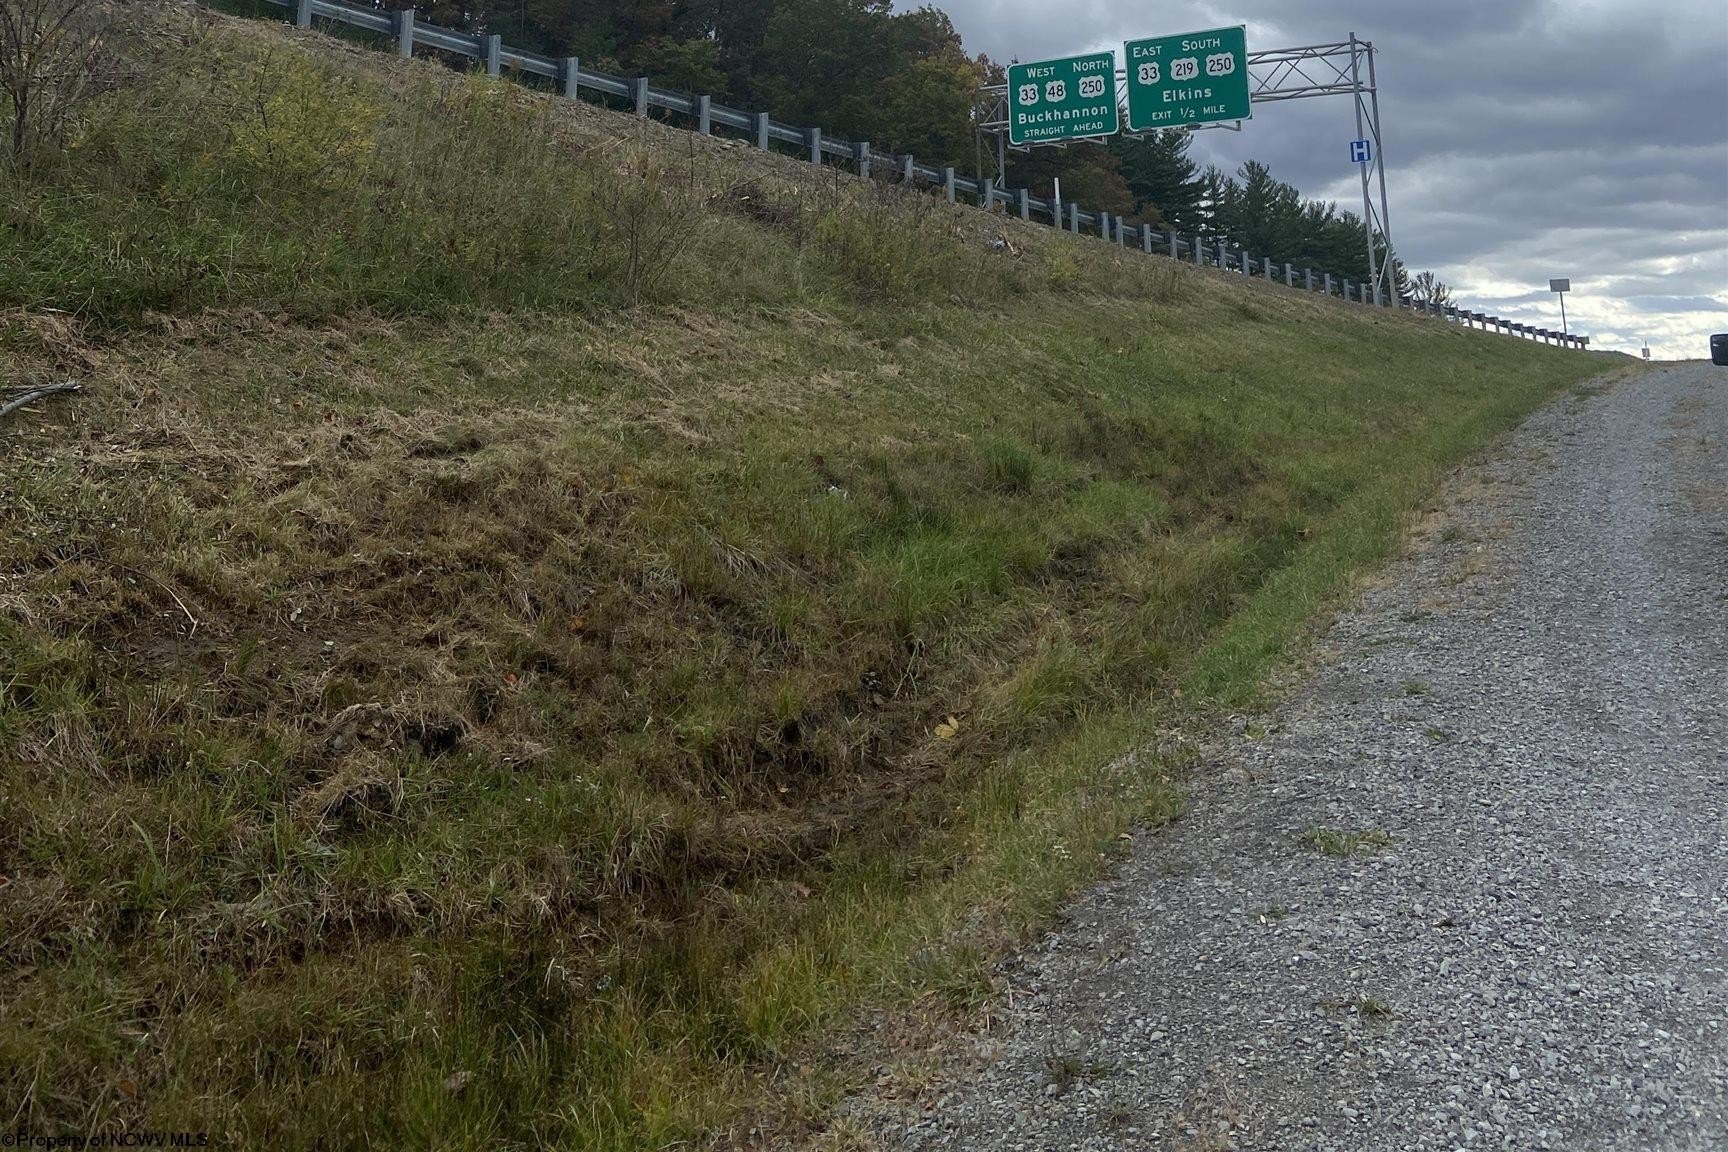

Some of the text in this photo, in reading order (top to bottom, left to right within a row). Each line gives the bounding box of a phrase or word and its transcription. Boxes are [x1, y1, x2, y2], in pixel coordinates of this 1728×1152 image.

[1133, 38, 1220, 58] EAST SOUTH
[1027, 60, 1109, 78] WEST NORTH
[1141, 57, 1231, 80] 33 219 250
[1021, 80, 1102, 101] 33 48 250
[1163, 88, 1212, 102] Elkins
[1018, 106, 1108, 124] Buckhannon
[1152, 110, 1172, 120] EXIT
[1203, 105, 1226, 115] MILE
[1024, 121, 1103, 137] STRAIGHT AHEAD
[1353, 141, 1369, 161] H
